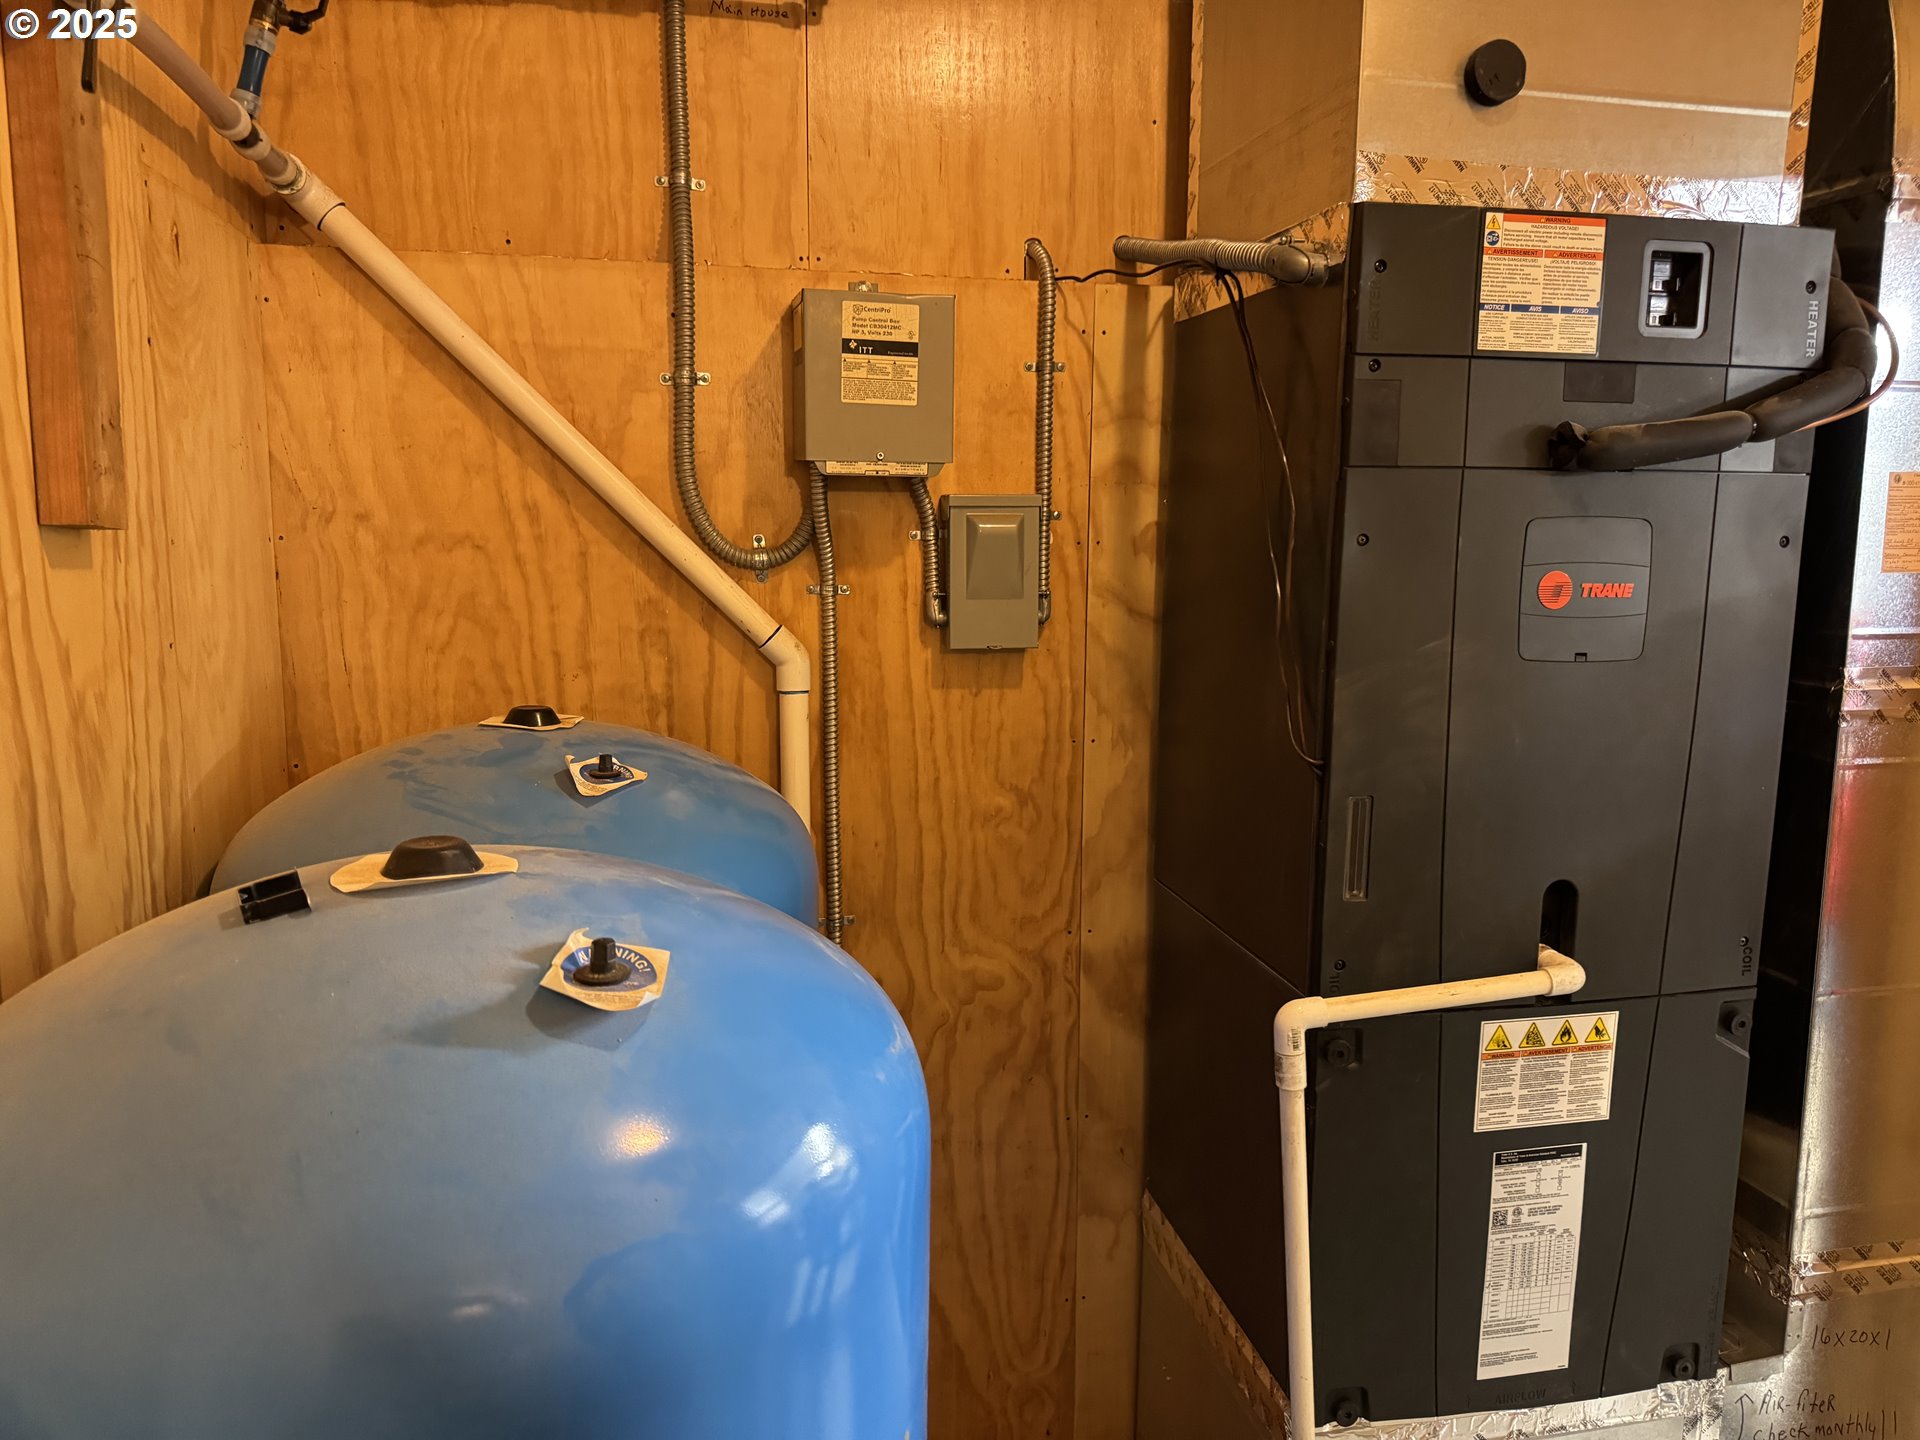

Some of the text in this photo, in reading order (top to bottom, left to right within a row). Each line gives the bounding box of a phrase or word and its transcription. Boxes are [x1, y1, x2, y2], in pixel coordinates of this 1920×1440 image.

[710, 0, 790, 18] Main House
[1806, 300, 1819, 358] HEATER
[859, 346, 873, 354] ITT
[1580, 583, 1634, 599] TRANE
[1741, 946, 1752, 976] COIL
[1528, 1048, 1568, 1056] AVERTISSEMENT
[1495, 1388, 1547, 1405] AIRFLOW
